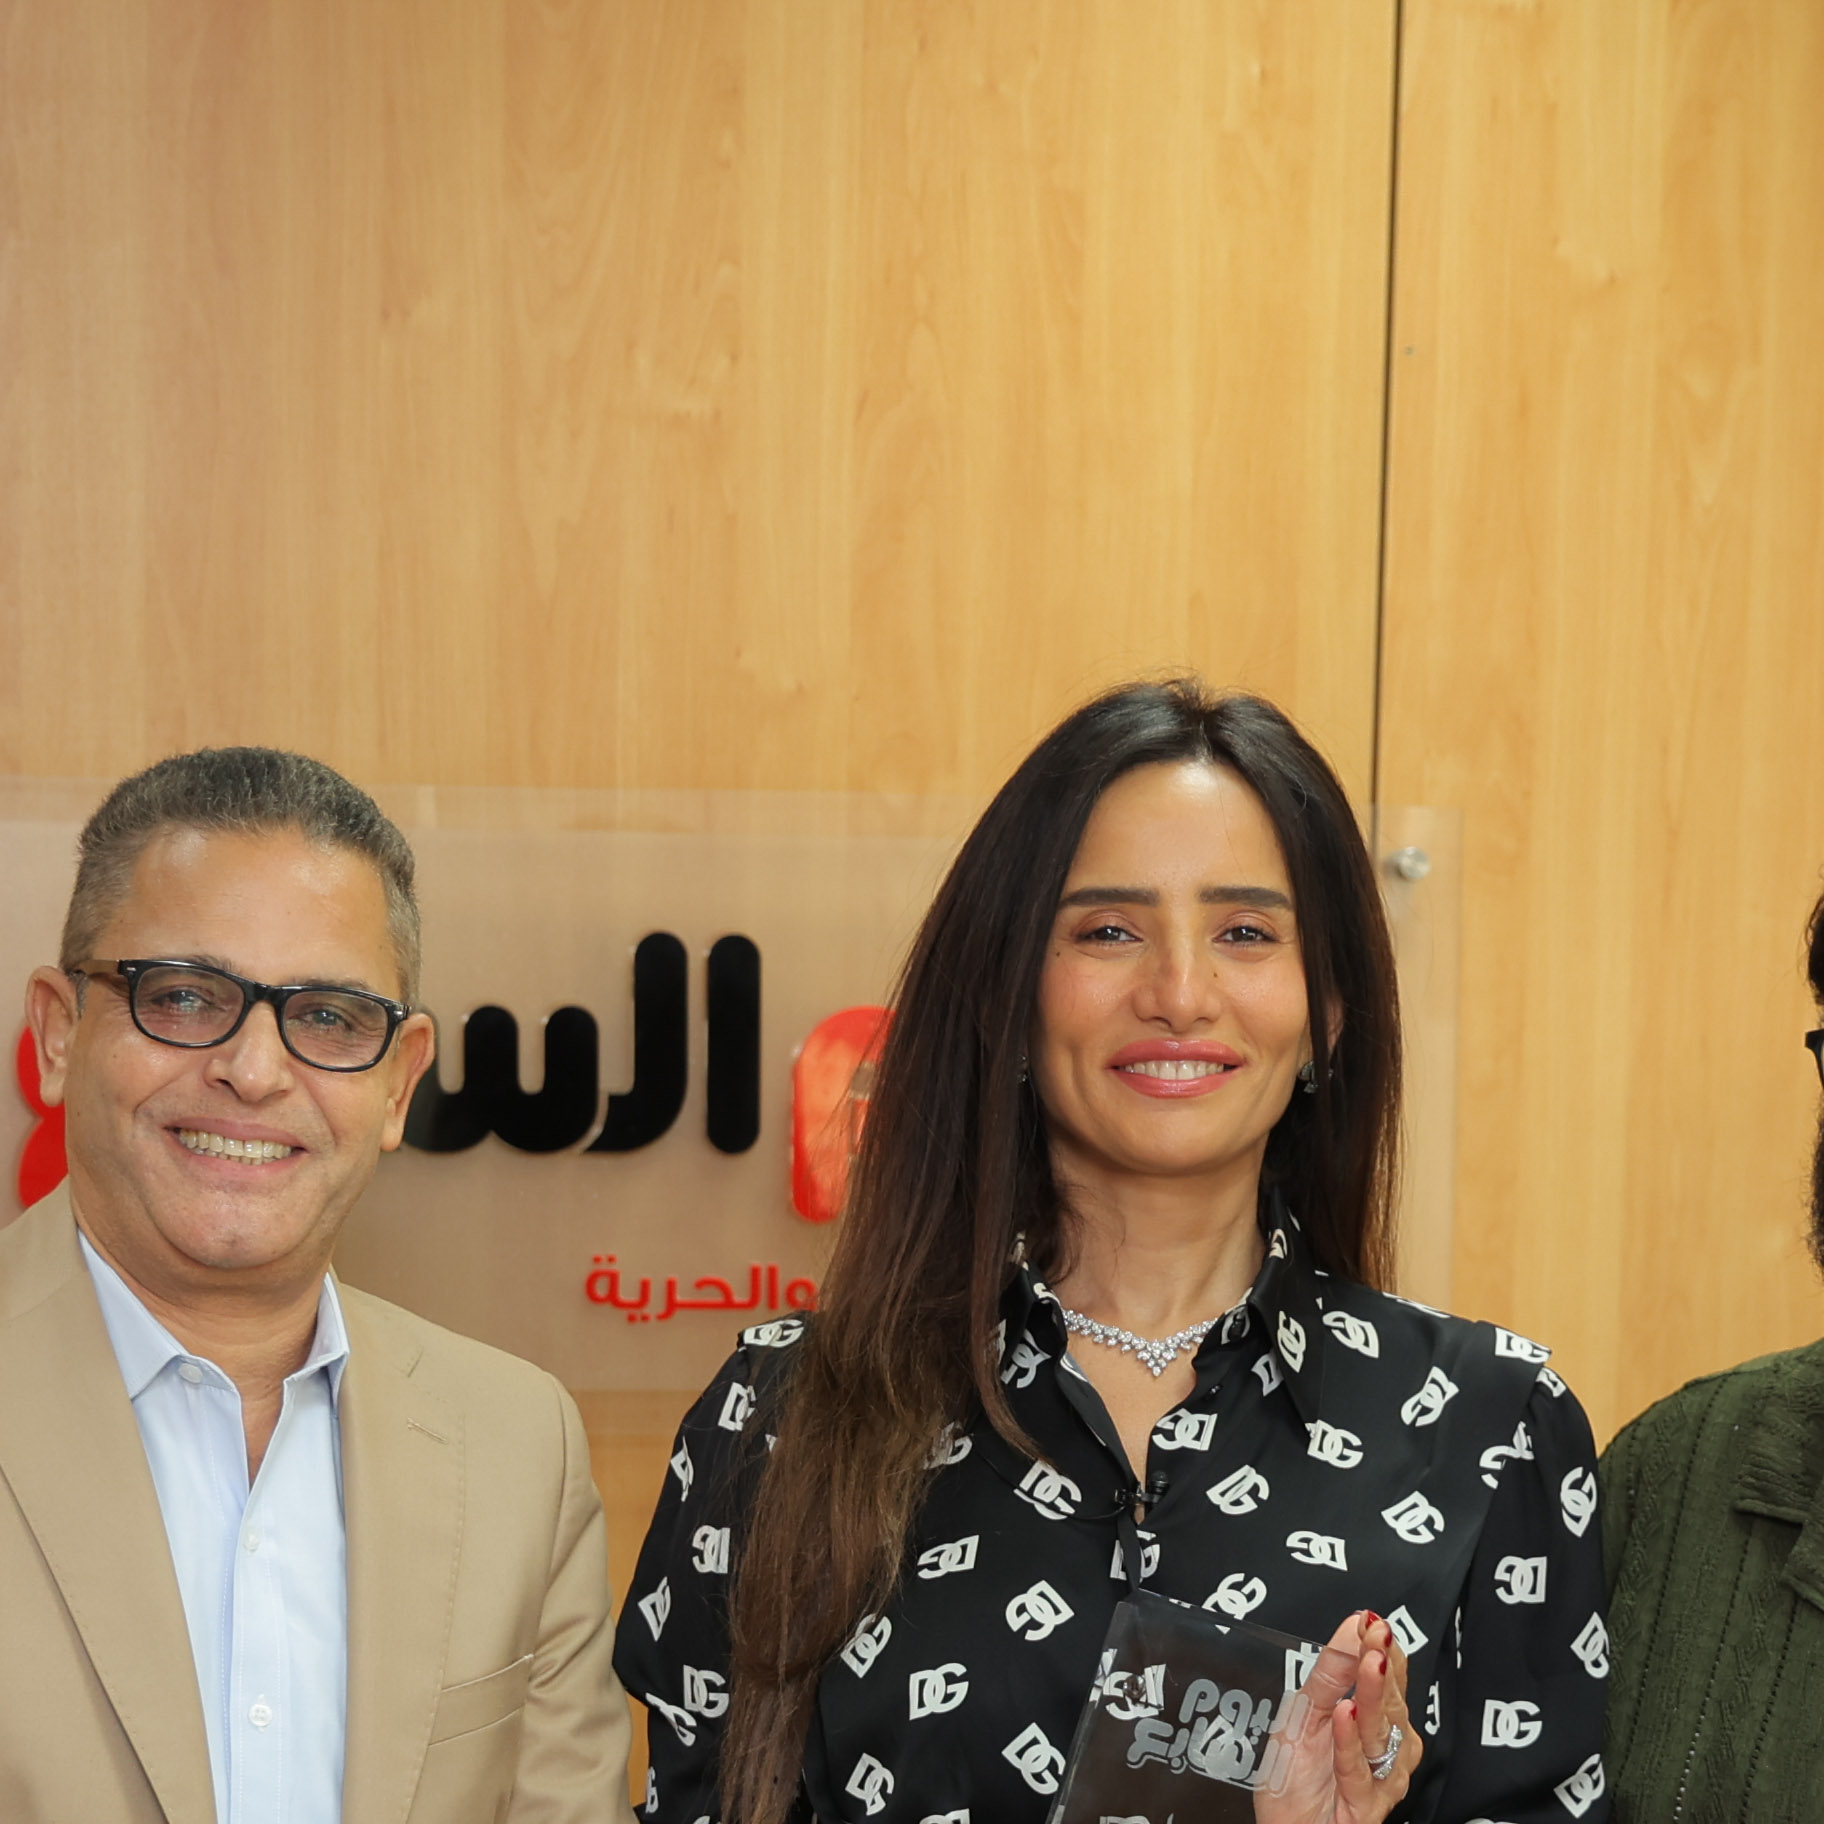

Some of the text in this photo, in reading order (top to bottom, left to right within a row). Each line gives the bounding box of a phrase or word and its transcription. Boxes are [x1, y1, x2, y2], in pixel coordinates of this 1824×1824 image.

[909, 1663, 969, 1720] DG
[1179, 1678, 1309, 1744] اليوم
[1481, 1699, 1542, 1748] DG
[1127, 1717, 1295, 1796] السابع
